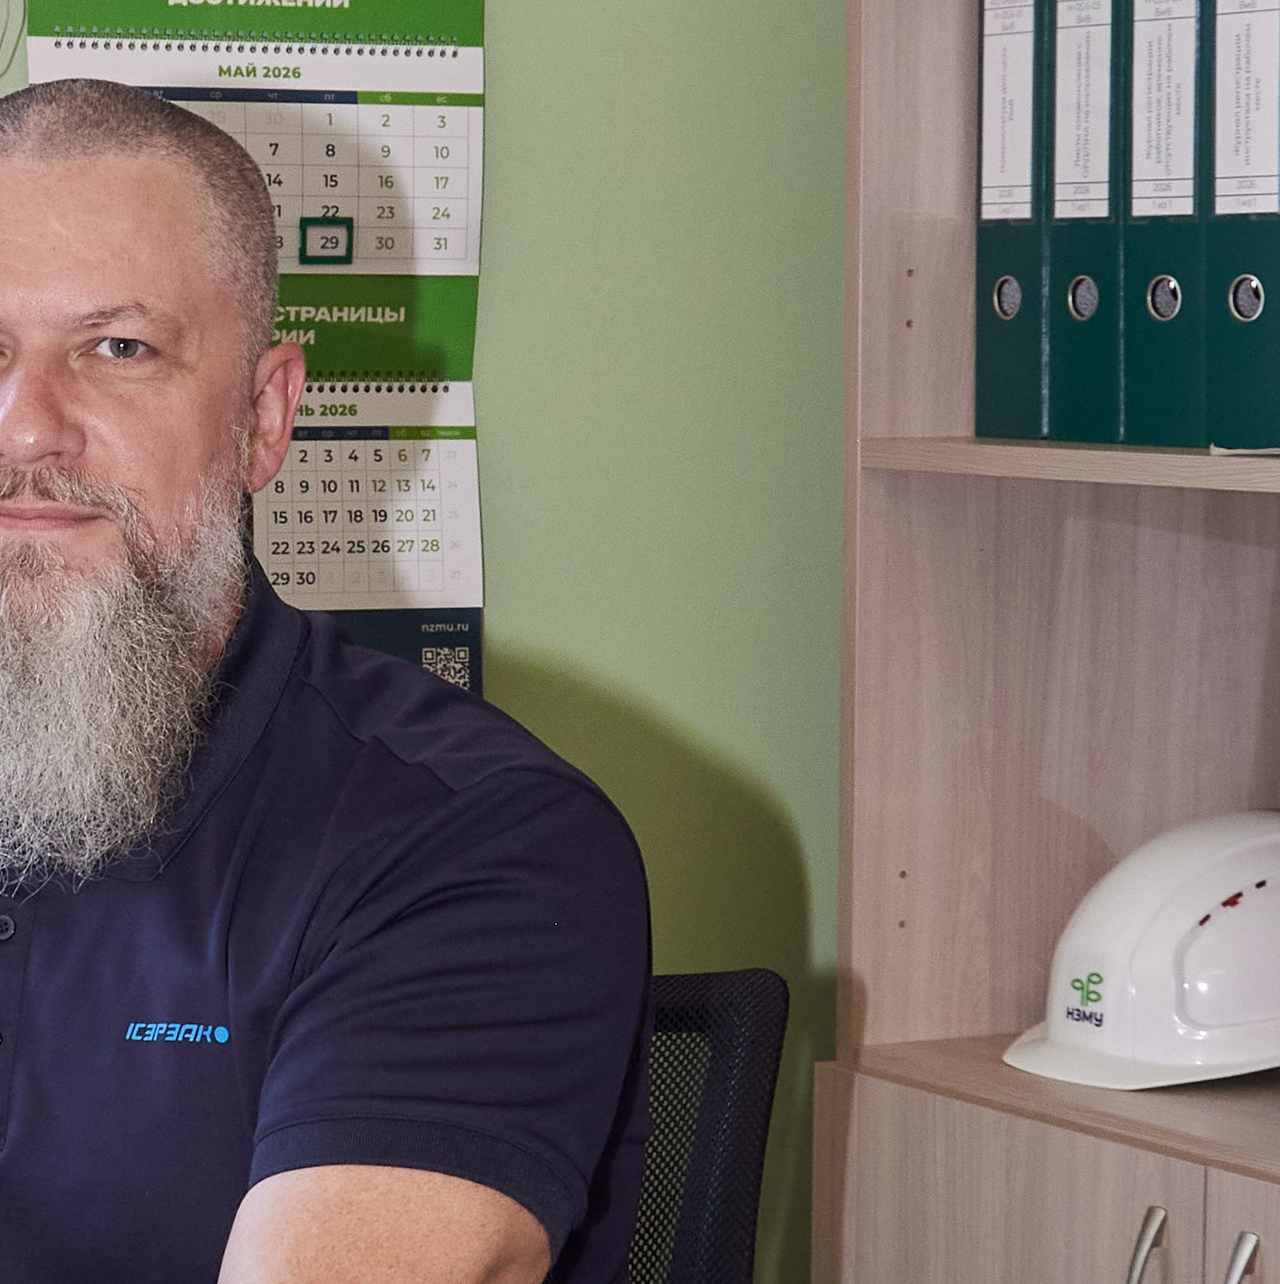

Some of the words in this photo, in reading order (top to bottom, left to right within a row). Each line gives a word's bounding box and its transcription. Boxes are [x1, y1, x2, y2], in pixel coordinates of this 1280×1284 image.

[218, 63, 258, 79] МАЙ
[262, 65, 301, 79] 2026
[326, 113, 333, 128] 1
[381, 114, 391, 128] 2
[436, 115, 446, 129] 3
[269, 142, 280, 157] 7
[325, 143, 335, 157] 8
[380, 144, 391, 159] 9
[433, 145, 451, 159] 10
[266, 173, 283, 187] 14
[322, 174, 339, 188] 15
[377, 174, 394, 189] 16
[433, 176, 450, 190] 17
[321, 204, 340, 218] 22
[376, 205, 395, 220] 23
[431, 206, 451, 221] 24
[320, 235, 339, 250] 29
[375, 236, 395, 251] 30
[433, 237, 449, 251] 31
[319, 404, 357, 417] 2026
[299, 449, 308, 462] 2
[323, 449, 333, 462] 3
[348, 449, 359, 462] 4
[373, 449, 383, 462] 5
[397, 449, 408, 462] 6
[421, 449, 431, 462] 7
[274, 480, 285, 493] 8
[299, 480, 309, 493] 9
[321, 480, 338, 493] 10
[349, 480, 360, 493] 11
[372, 479, 386, 492] 12
[396, 479, 411, 492] 13
[420, 479, 436, 492] 14
[272, 511, 288, 524] 15
[297, 511, 313, 524] 16
[323, 510, 338, 523] 17
[347, 510, 363, 523] 18
[372, 510, 387, 523] 19
[395, 509, 414, 522] 20
[421, 509, 436, 522] 21
[271, 542, 290, 555] 22
[296, 541, 315, 554] 23
[321, 541, 341, 554] 24
[346, 540, 365, 554] 25
[371, 540, 391, 553] 26
[396, 540, 414, 553] 27
[420, 539, 440, 552] 28
[271, 572, 290, 585] 29
[296, 572, 316, 585] 30
[421, 622, 469, 632] nzmu.ru
[1066, 1007, 1104, 1027] НЗМУ
[126, 1023, 212, 1043] ICEPEAK
